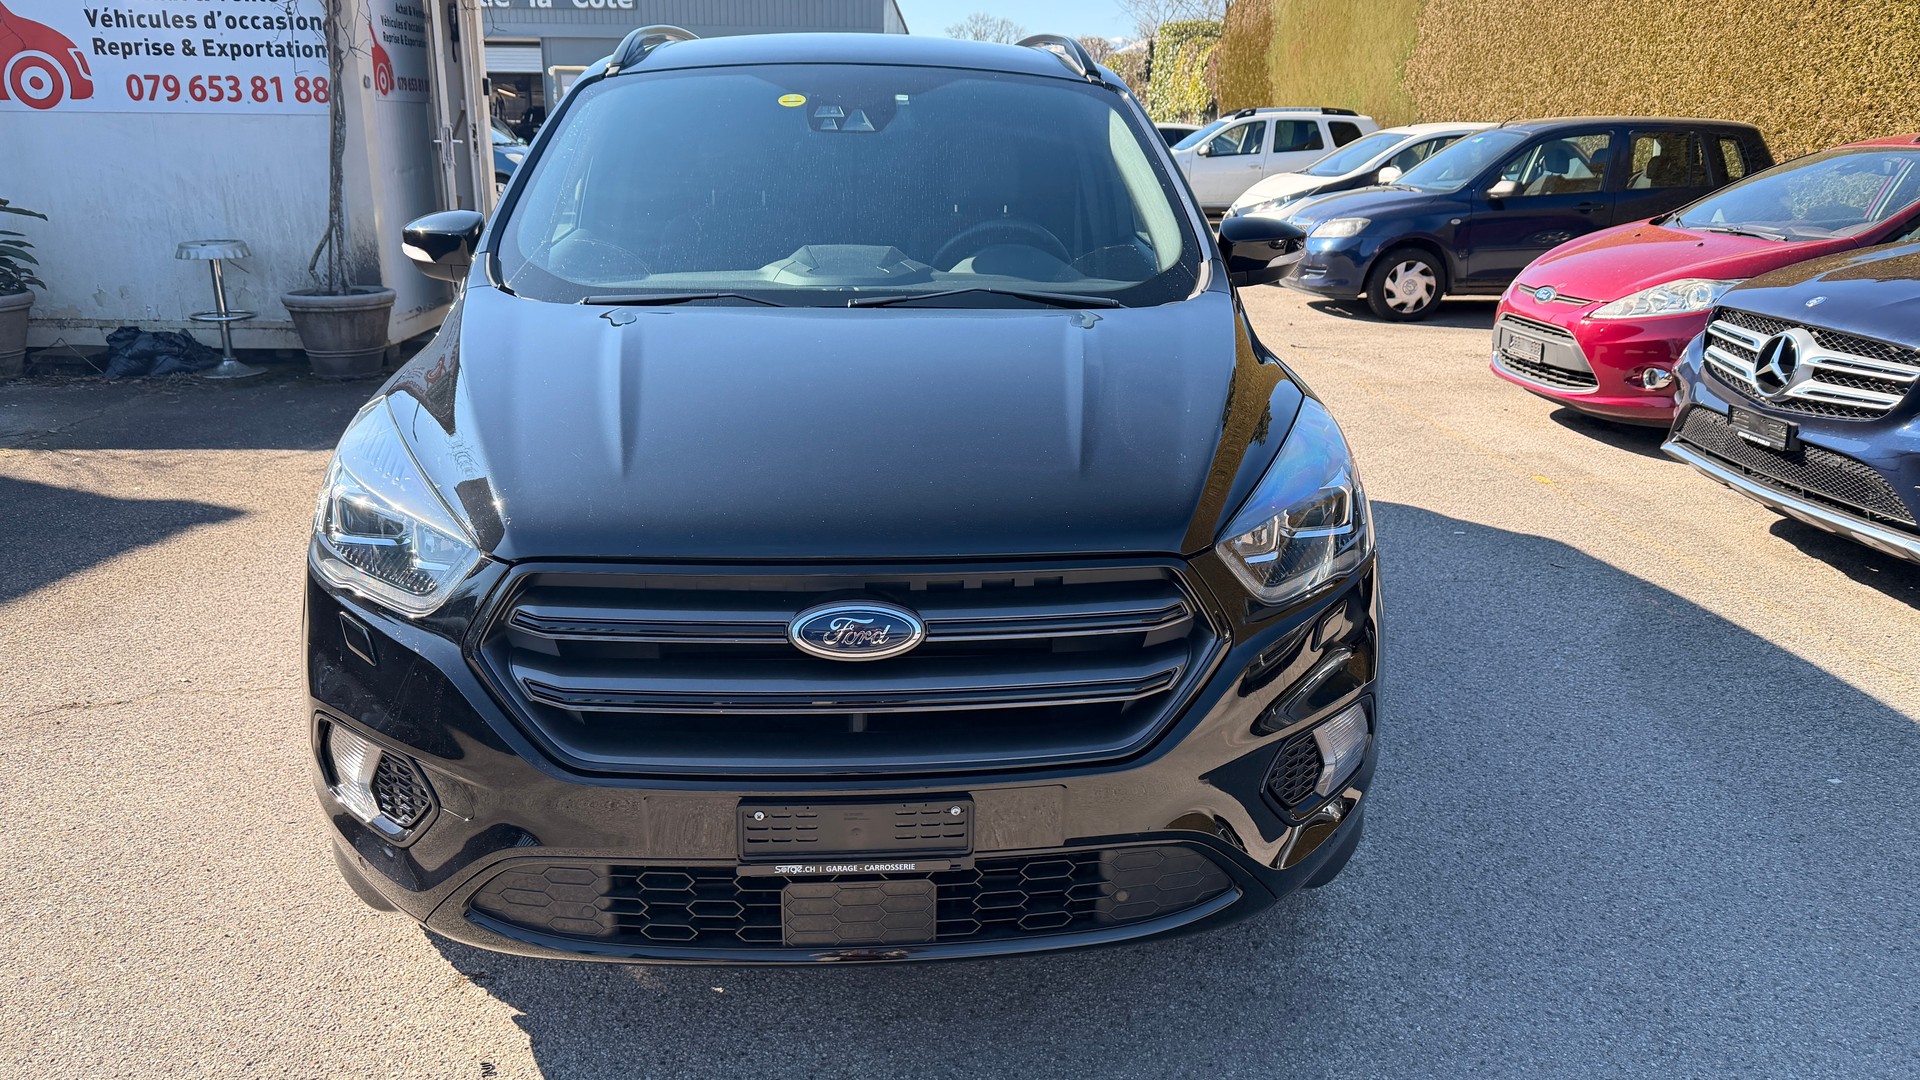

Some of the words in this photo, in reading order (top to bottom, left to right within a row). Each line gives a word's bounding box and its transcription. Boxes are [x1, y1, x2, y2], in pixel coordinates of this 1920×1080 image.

[83, 7, 198, 29] Véhicules
[203, 10, 323, 31] d'occasion
[92, 37, 175, 60] Reprise
[181, 38, 198, 57] &
[202, 38, 327, 61] Exportation
[126, 73, 181, 101] 079
[188, 74, 243, 102] 653
[250, 75, 283, 103] 81
[294, 76, 330, 104] 88
[822, 617, 891, 645] Ford
[826, 865, 858, 873] GARAGE
[864, 863, 916, 871] CARROSSERIE
